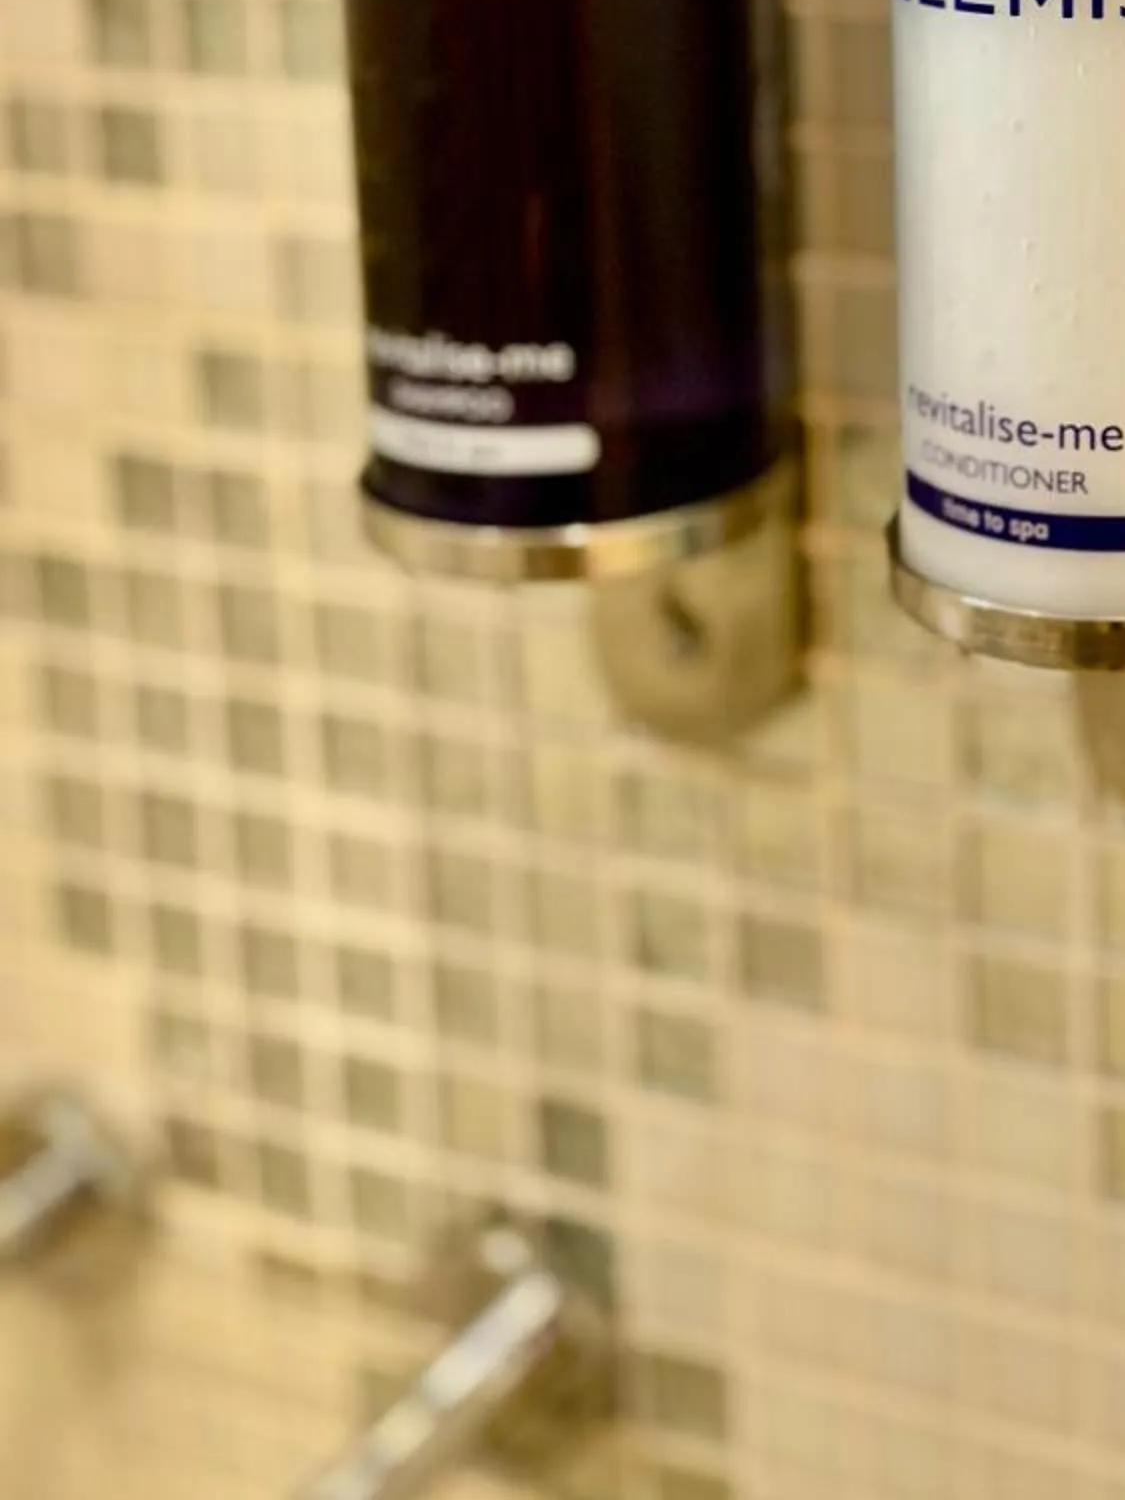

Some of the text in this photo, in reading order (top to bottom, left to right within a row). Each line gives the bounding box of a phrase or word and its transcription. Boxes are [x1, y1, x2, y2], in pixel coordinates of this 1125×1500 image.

[908, 384, 1125, 452] revitalise-me
[920, 439, 1090, 495] CONDITIONER
[941, 497, 1050, 542] time to spa
